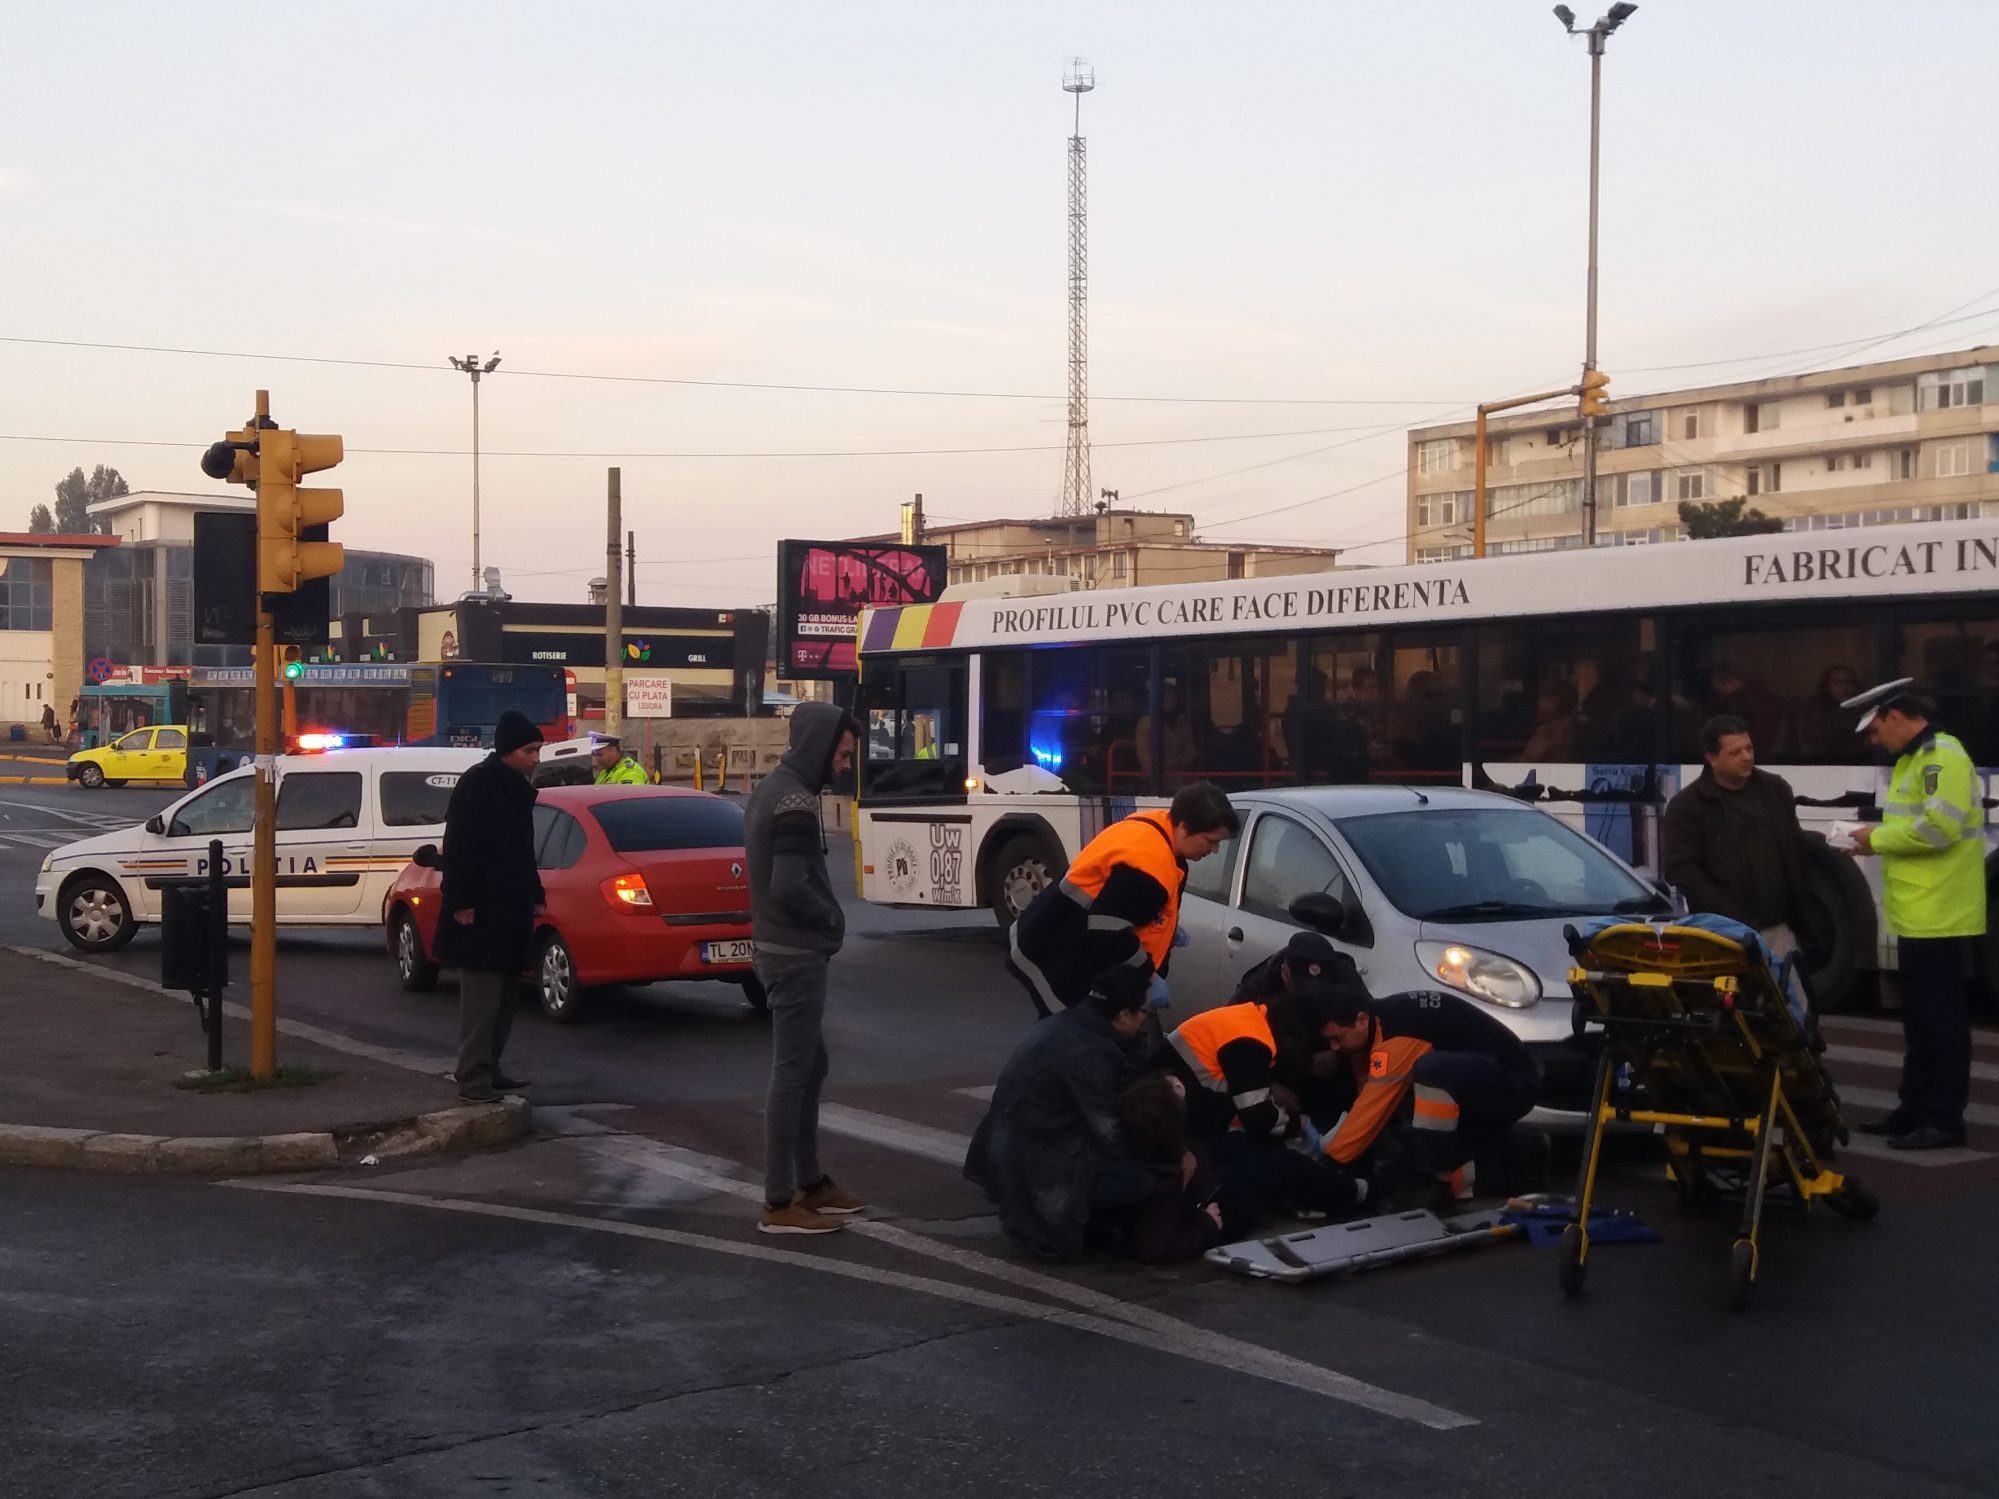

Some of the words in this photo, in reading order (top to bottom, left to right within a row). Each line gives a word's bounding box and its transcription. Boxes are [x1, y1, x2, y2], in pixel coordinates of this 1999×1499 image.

[1743, 541, 1943, 585] FABRICAT
[1956, 537, 1999, 572] IN
[991, 604, 1100, 634] PROFILUL
[1105, 601, 1151, 627] PVC
[1157, 597, 1224, 624] CARE
[1232, 591, 1298, 620] FACE
[1306, 577, 1470, 616] DIFERENTA
[820, 614, 847, 623] BONUS
[821, 625, 846, 633] TRAFIC
[532, 651, 567, 660] ROTISERIE
[687, 654, 706, 662] GRILL
[629, 679, 668, 688] PARCARE
[628, 691, 640, 700] CU
[642, 691, 668, 700] PLATA
[930, 823, 961, 849] Uw
[197, 856, 318, 875] POLTIA
[930, 850, 962, 889] 0,87
[709, 943, 727, 958] TL
